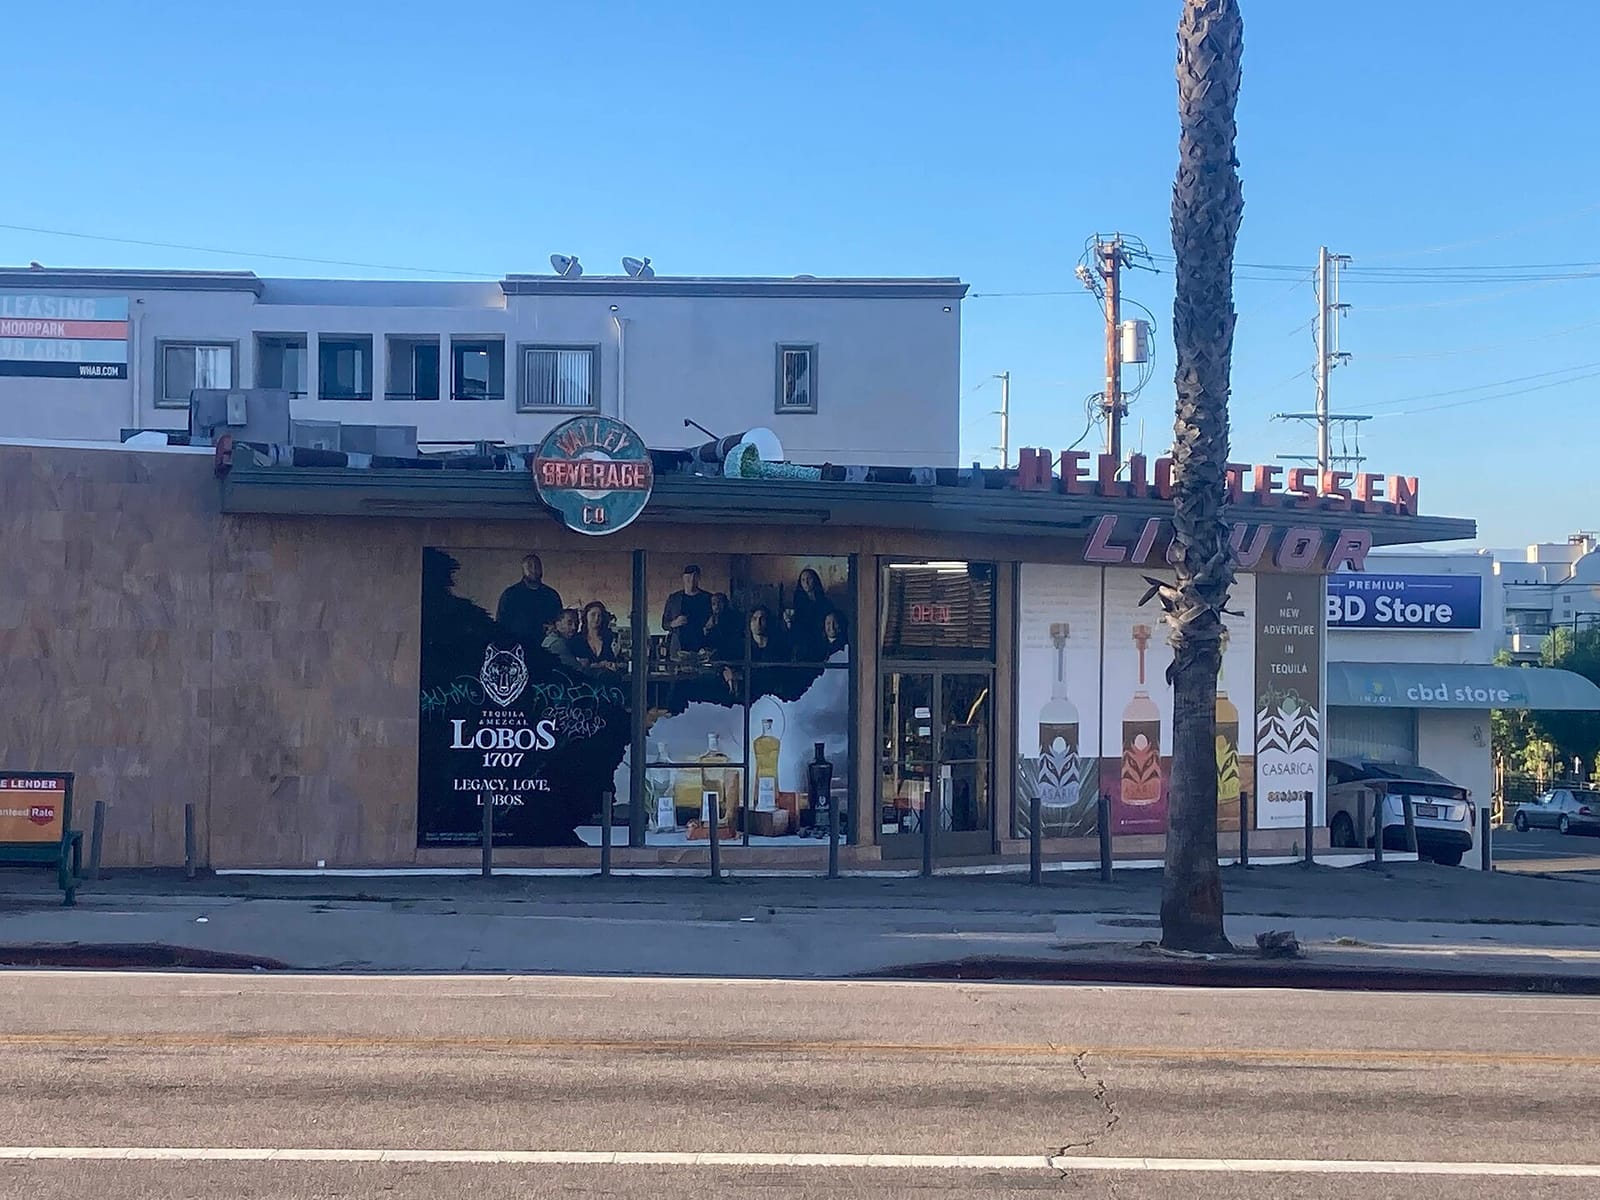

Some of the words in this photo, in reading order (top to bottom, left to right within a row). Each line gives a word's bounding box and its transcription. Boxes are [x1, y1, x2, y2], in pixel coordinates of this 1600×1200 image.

[2, 296, 96, 319] LEASING
[1, 321, 65, 337] MOORPARK
[79, 366, 119, 376] WHAB.COM
[542, 462, 646, 488] BEVERAGE
[583, 506, 605, 524] CO
[1083, 513, 1374, 572] LIUOR
[1348, 580, 1405, 591] PREMIUM
[1286, 591, 1293, 601] A
[1279, 609, 1300, 618] NEW
[1374, 596, 1453, 623] Store
[1263, 625, 1315, 635] ADVENTURE
[1285, 645, 1294, 654] IN
[1270, 664, 1308, 674] TEQUILA
[1407, 682, 1449, 701] cbd
[1454, 686, 1509, 702] store
[482, 710, 525, 718] TEQUILA
[449, 719, 557, 751] LOBOS
[482, 752, 525, 767] 1707
[1262, 762, 1314, 776] CASARICA
[11, 780, 57, 789] LENDER
[454, 779, 509, 791] LEGACY,
[513, 779, 551, 792] LOVE,
[31, 808, 54, 817] Rate
